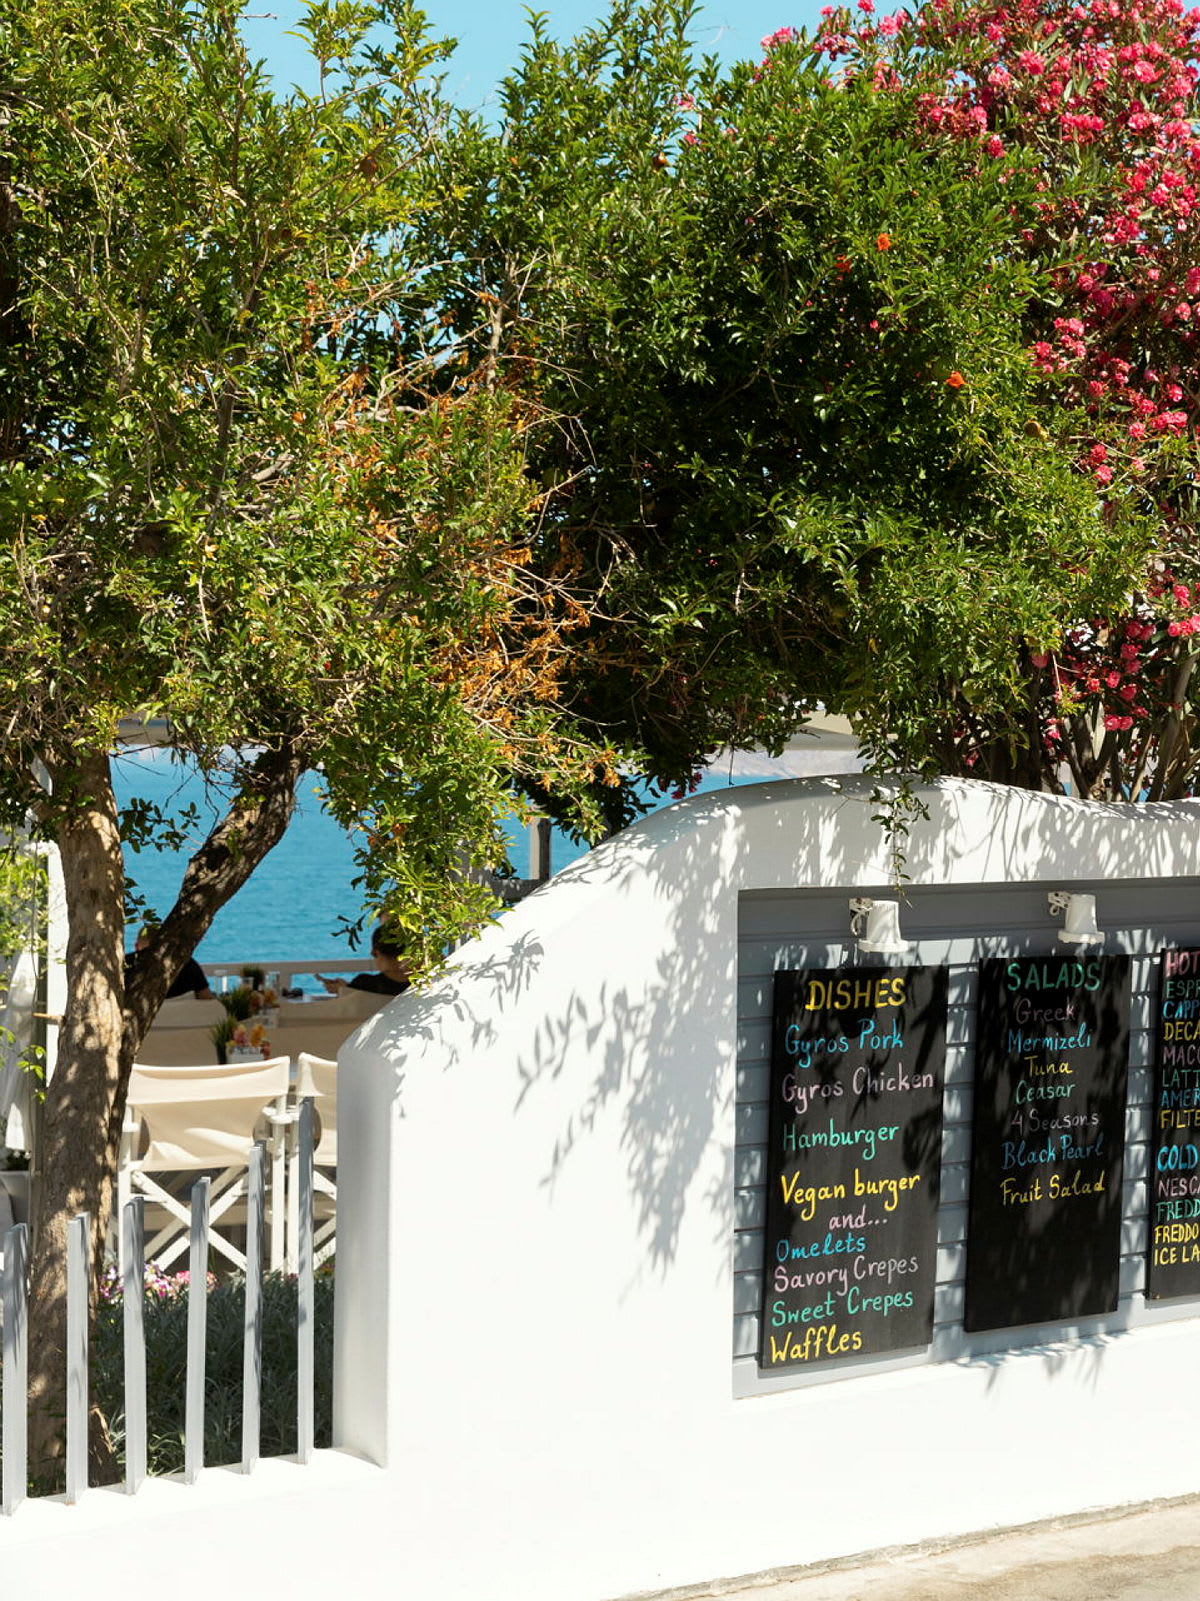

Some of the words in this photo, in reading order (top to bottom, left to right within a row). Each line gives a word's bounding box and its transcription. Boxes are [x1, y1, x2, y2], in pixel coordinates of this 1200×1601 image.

[1007, 962, 1101, 991] SALADS
[805, 977, 907, 1011] DISHES
[1015, 996, 1076, 1025] Greek
[785, 1024, 849, 1069] Gyros
[857, 1018, 904, 1049] Pork
[1007, 1022, 1092, 1053] Mermizeli
[1024, 1055, 1074, 1077] Tuna
[782, 1073, 844, 1115] Gyros
[852, 1062, 935, 1095] Chicken
[1016, 1080, 1076, 1105] Ceasar
[1011, 1110, 1023, 1135] 4
[1029, 1108, 1100, 1132] Seasons
[783, 1117, 900, 1161] Hamburger
[1000, 1137, 1056, 1170] Black
[1060, 1132, 1105, 1161] Pearl
[1157, 1142, 1199, 1172] COLD
[781, 1170, 846, 1222] Vegan
[854, 1168, 921, 1212] burger
[1000, 1177, 1043, 1206] Fruit
[1049, 1169, 1106, 1199] Salad
[776, 1232, 868, 1262] Omelets
[1154, 1222, 1200, 1244] FREDDO
[1153, 1246, 1178, 1266] ICE
[774, 1265, 849, 1297] Savory
[853, 1255, 920, 1284] Crepes
[771, 1290, 836, 1327] Sweet
[847, 1286, 914, 1317] Crepes
[770, 1324, 863, 1363] Waffles
